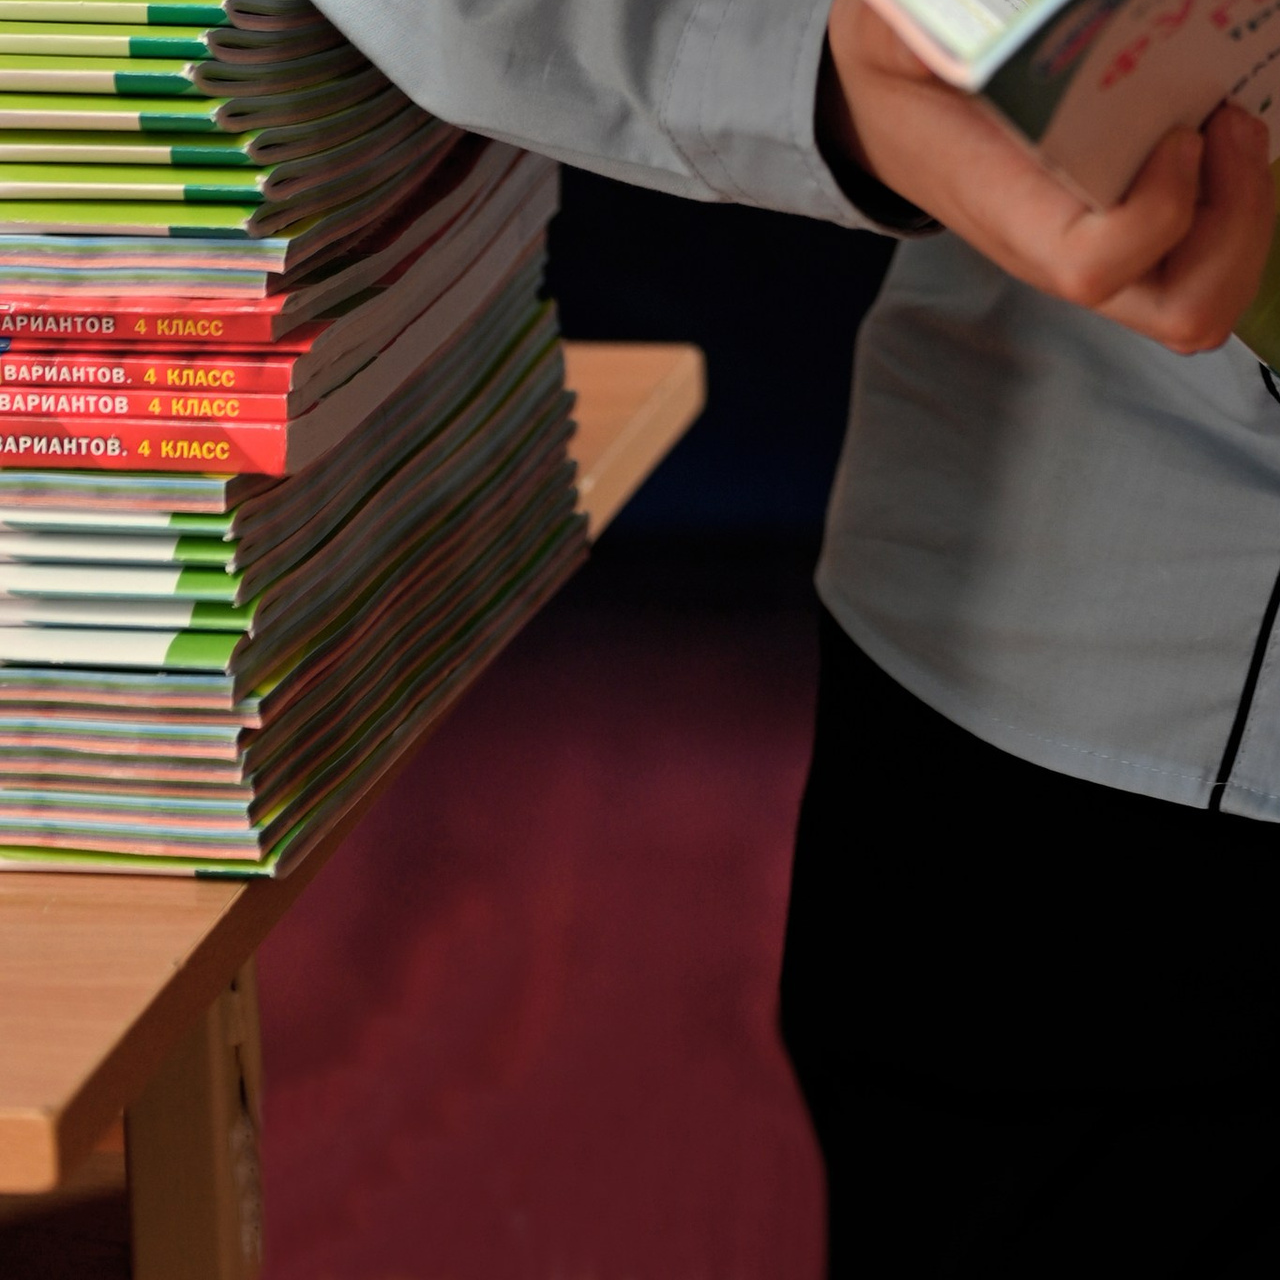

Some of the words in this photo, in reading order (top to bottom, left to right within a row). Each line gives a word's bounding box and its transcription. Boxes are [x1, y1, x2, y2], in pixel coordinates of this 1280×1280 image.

[0, 315, 115, 334] АРИАНТОВ
[134, 318, 147, 335] 4
[156, 319, 224, 336] КЛАСС
[3, 364, 132, 384] ВАРИАНТОВ.
[144, 369, 157, 384] 4
[167, 369, 235, 387] КЛАСС
[0, 394, 129, 414] ВАРИАНТОВ
[148, 398, 161, 415] 4
[171, 399, 240, 417] КЛАСС
[0, 435, 128, 457] АРИАНТОВ.
[137, 440, 151, 457] 4
[160, 440, 230, 459] КЛАСС
